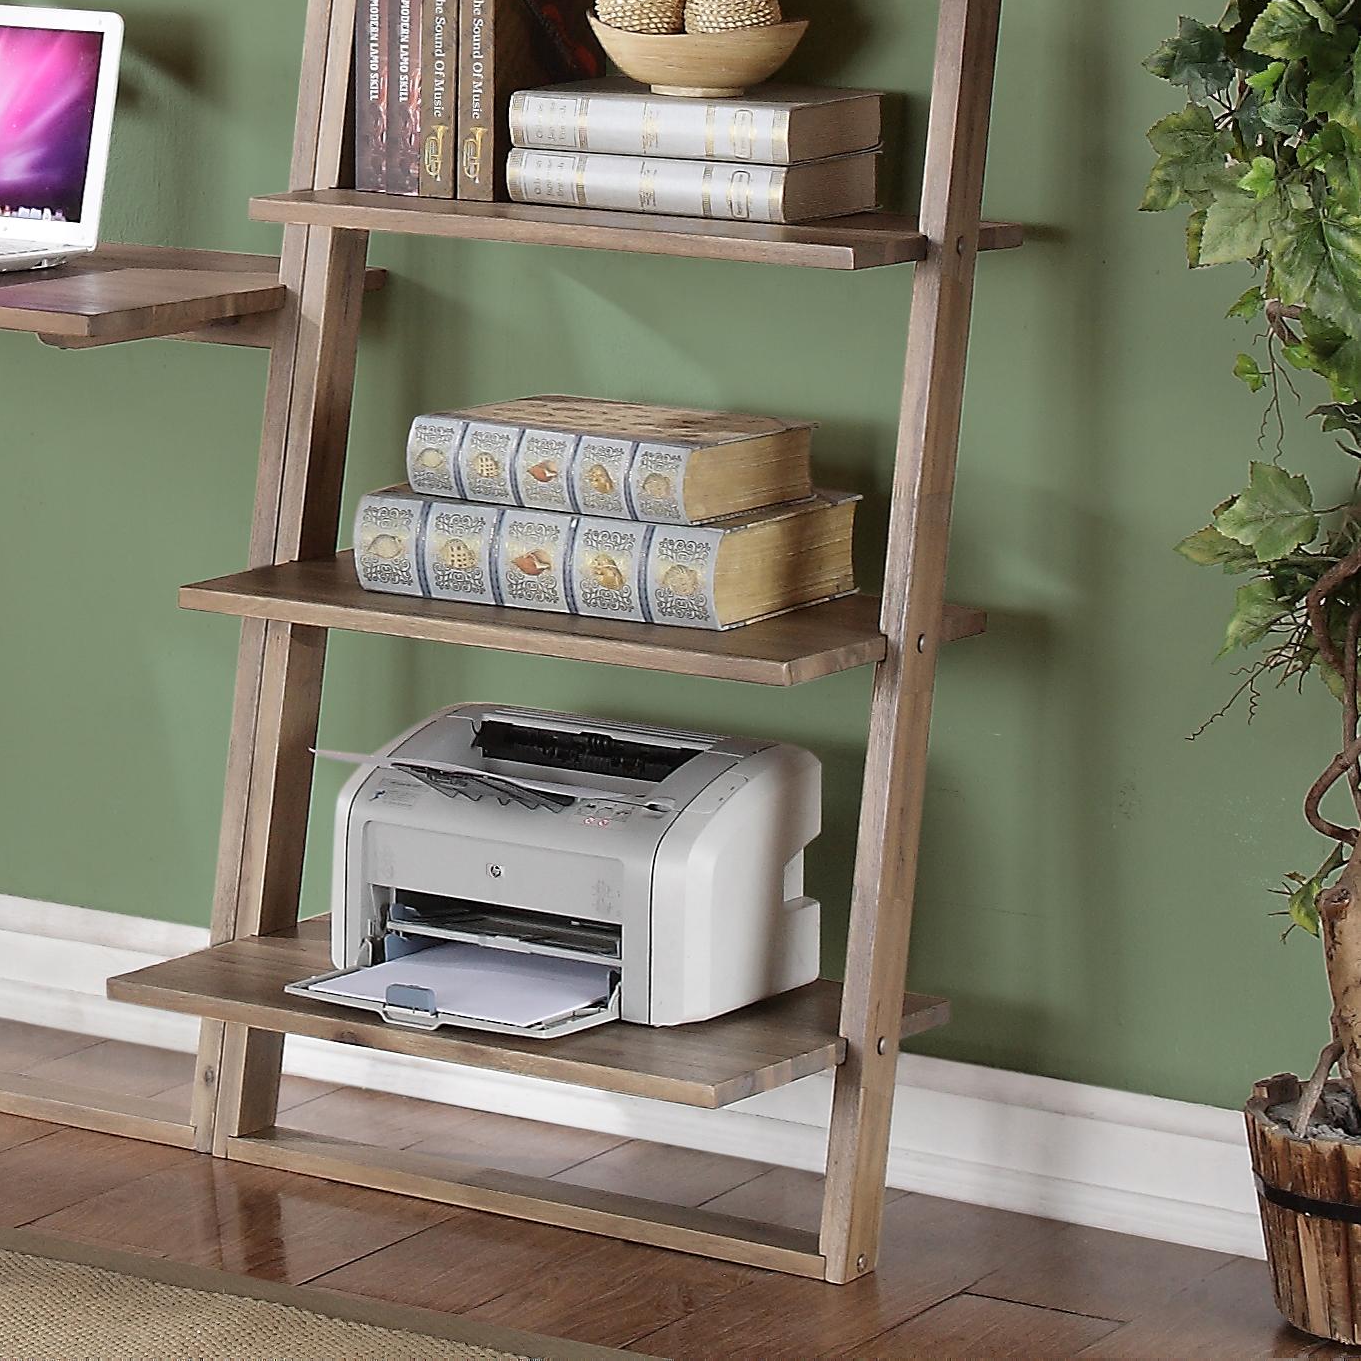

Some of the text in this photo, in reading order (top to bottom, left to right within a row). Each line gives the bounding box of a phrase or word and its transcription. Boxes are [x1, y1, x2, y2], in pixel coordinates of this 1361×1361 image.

[400, 0, 410, 43] MODERN
[434, 16, 446, 57] Sound
[472, 18, 484, 59] Sound
[369, 72, 379, 101] SKILL
[399, 74, 409, 103] SKILL
[434, 60, 445, 78] Of
[472, 61, 483, 80] Of
[433, 79, 445, 118] Music
[471, 81, 483, 120] Music
